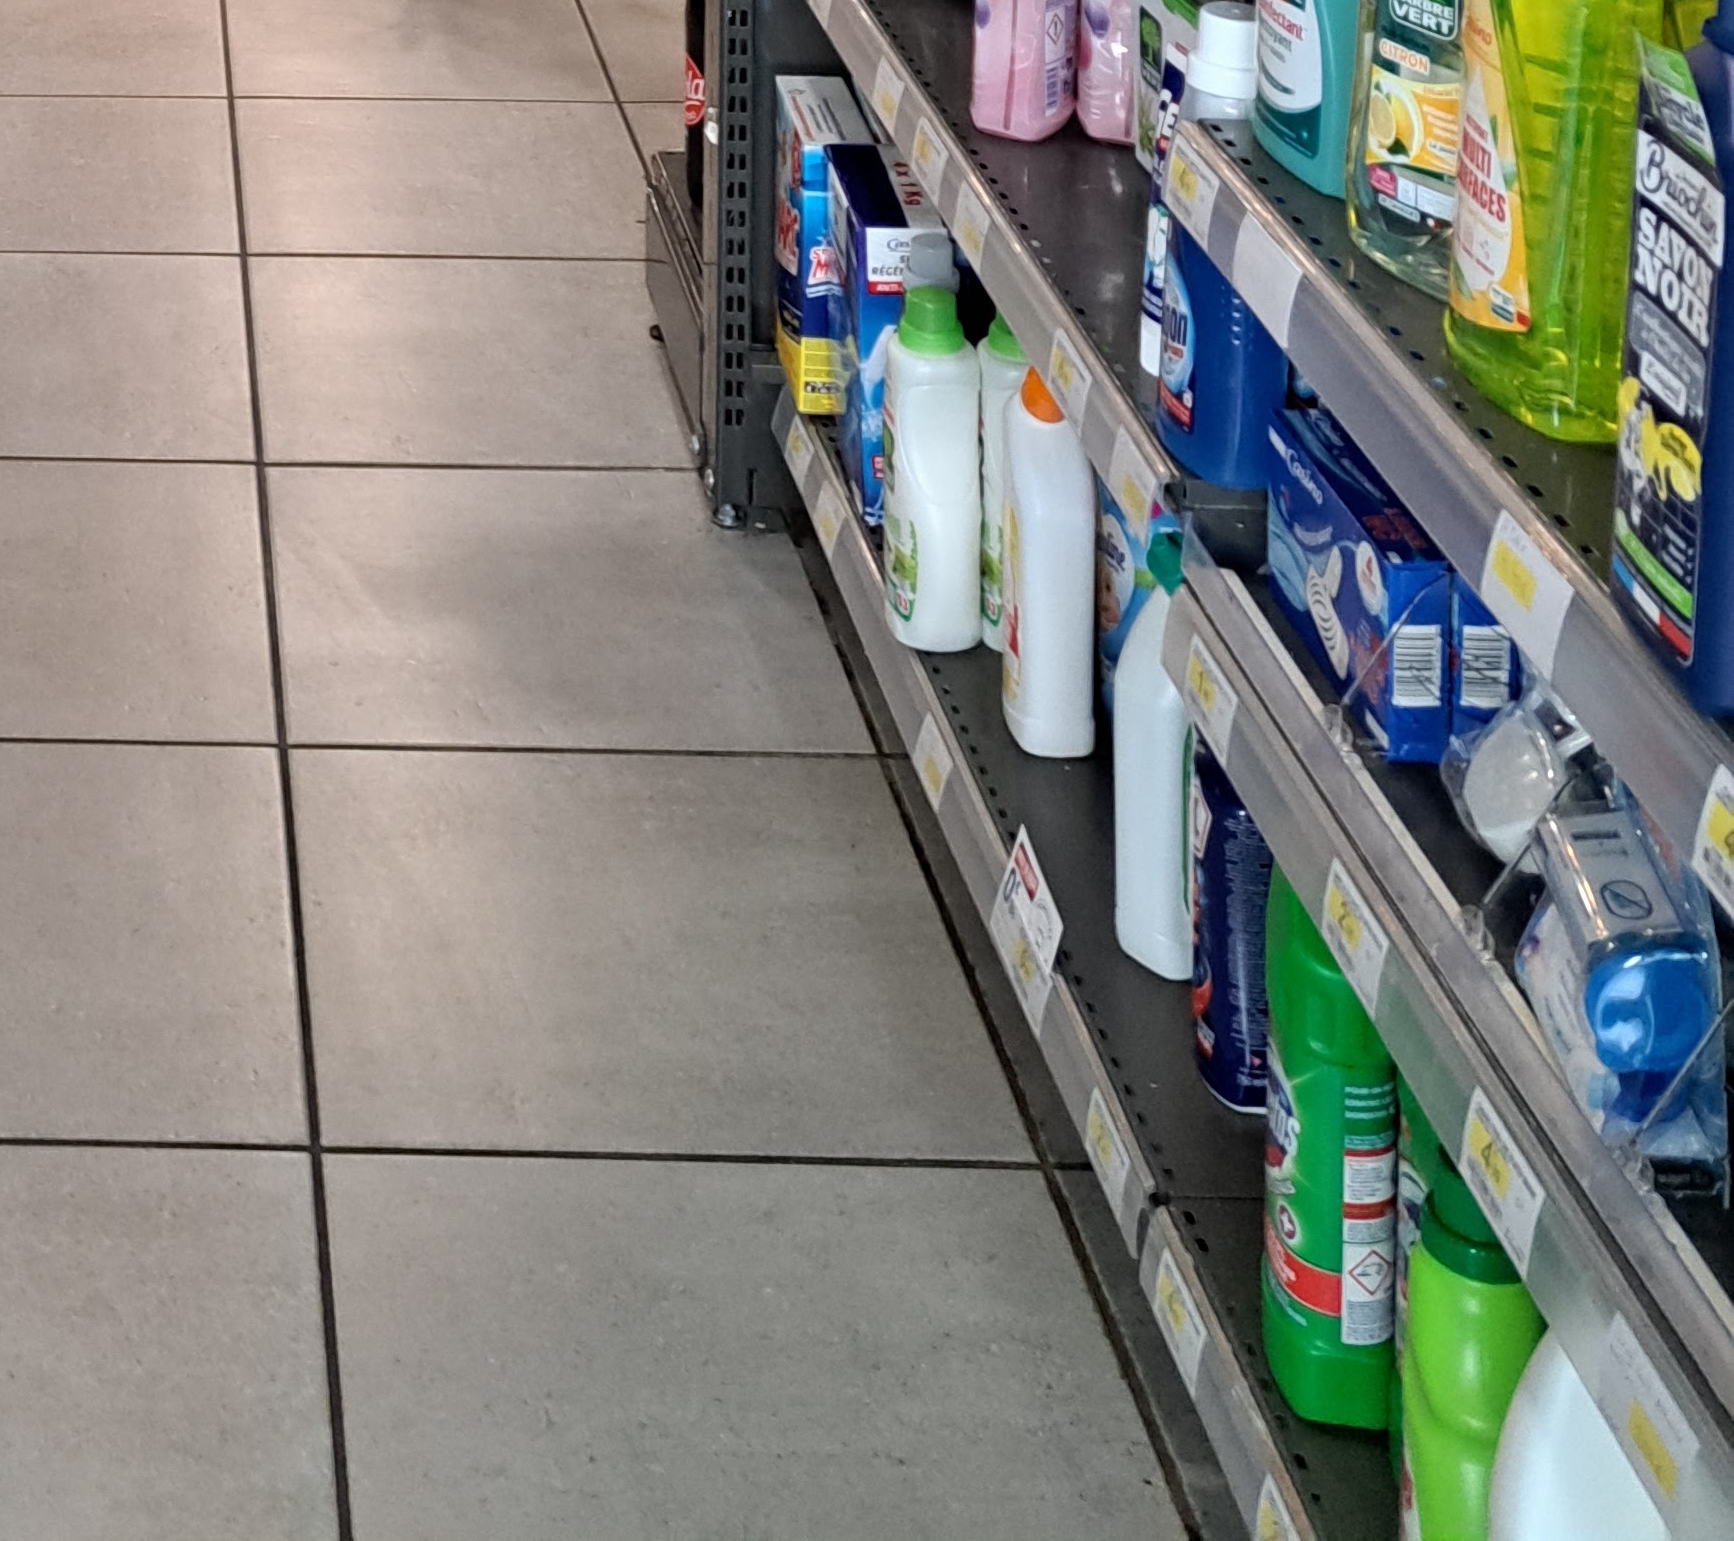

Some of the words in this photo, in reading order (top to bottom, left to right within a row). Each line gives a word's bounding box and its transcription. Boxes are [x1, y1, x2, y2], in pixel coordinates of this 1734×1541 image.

[1380, 38, 1430, 74] CITRON
[1638, 207, 1715, 298] SAVON
[1634, 254, 1710, 347] NOIR
[1282, 447, 1324, 506] Casino
